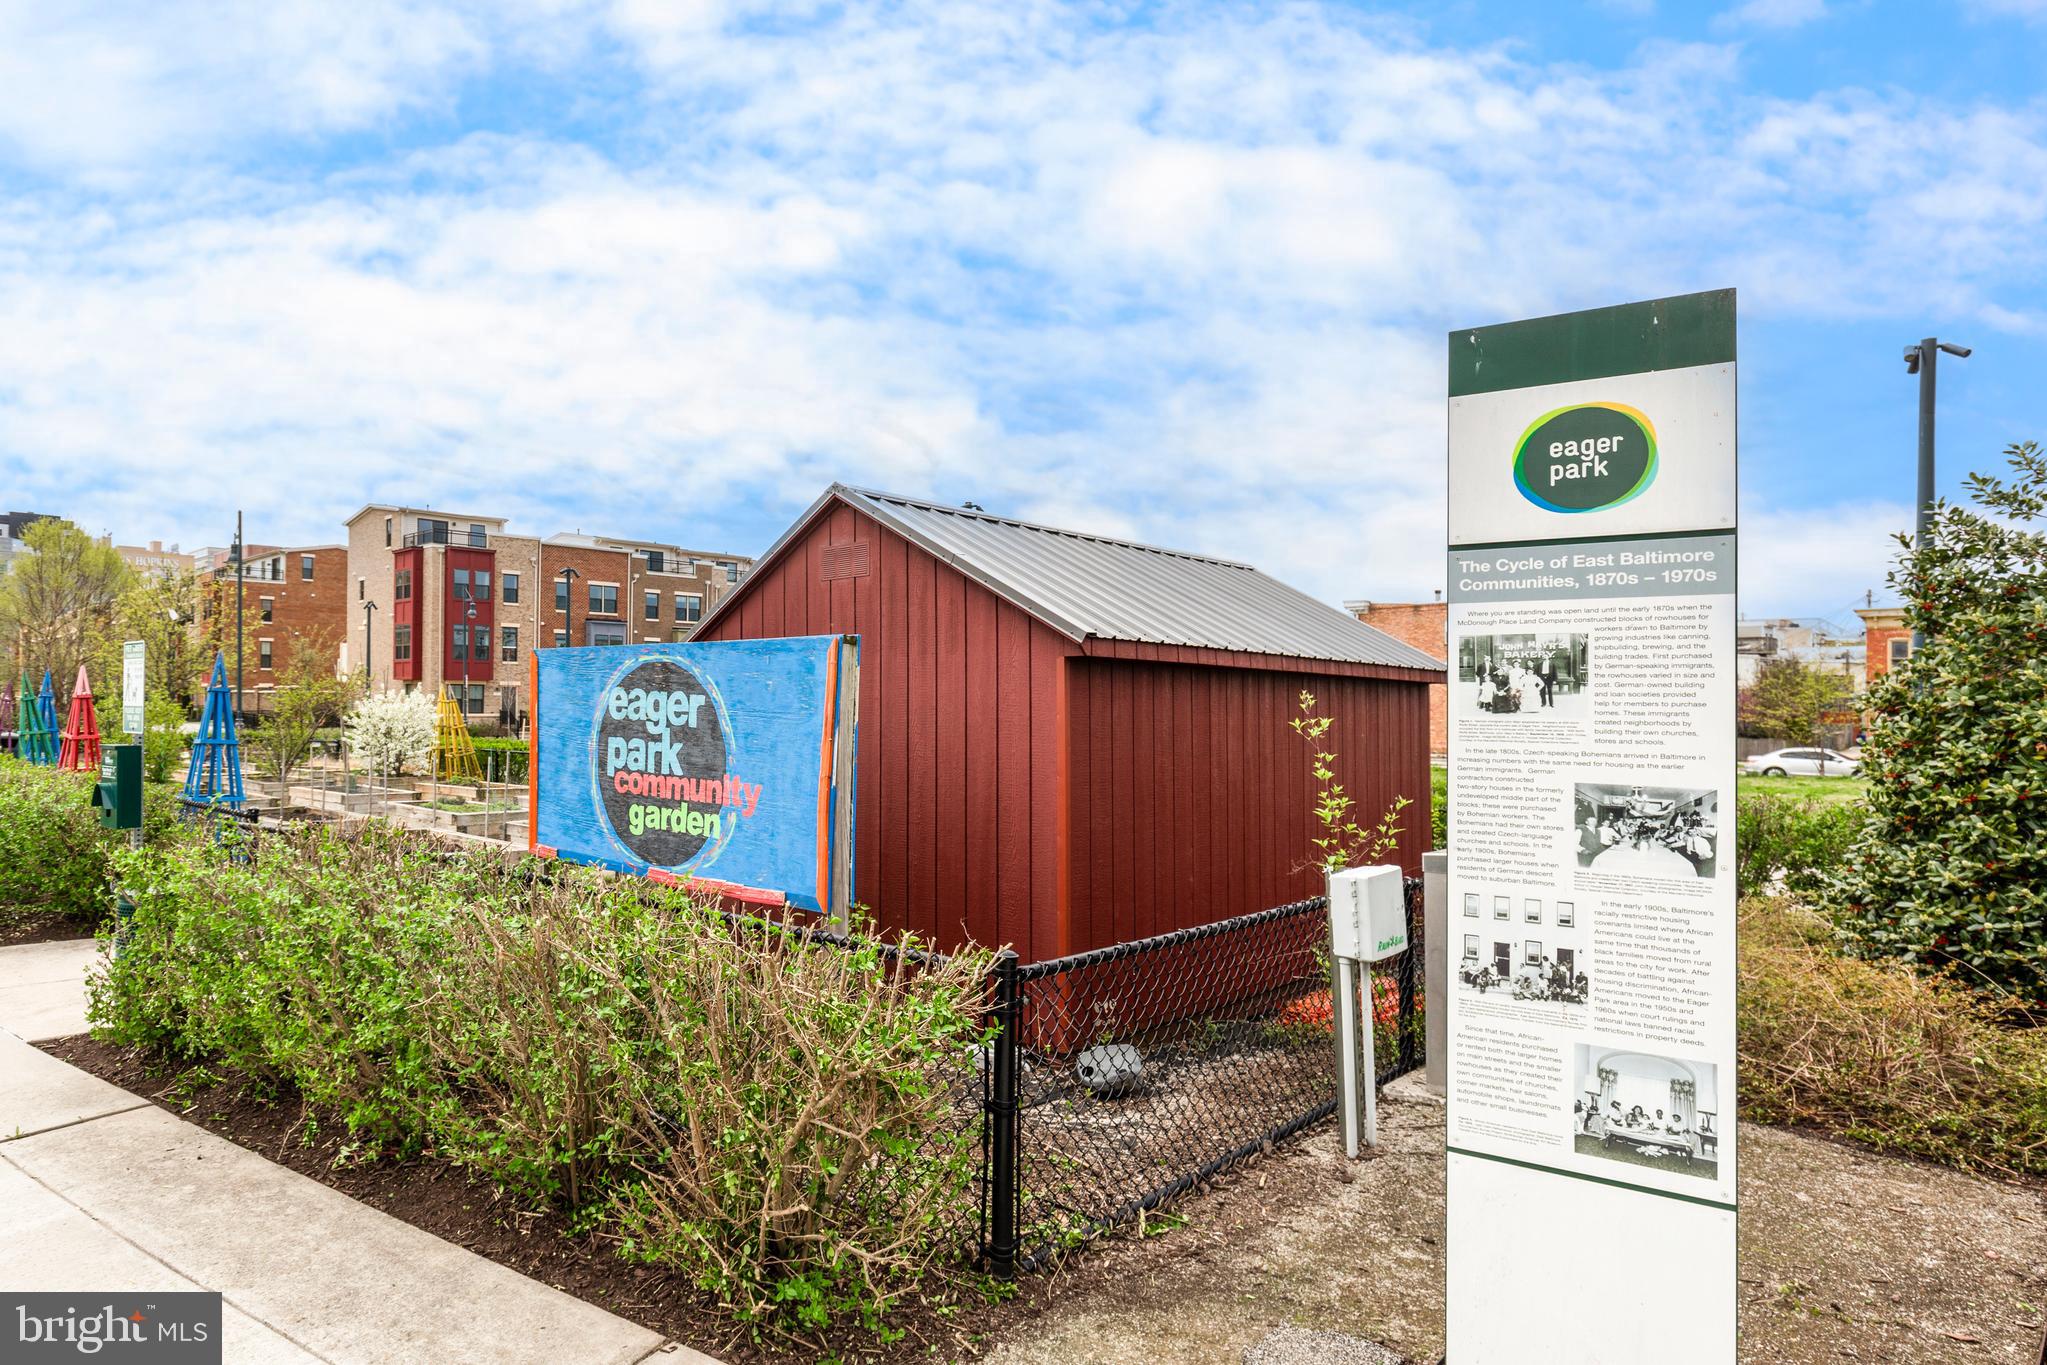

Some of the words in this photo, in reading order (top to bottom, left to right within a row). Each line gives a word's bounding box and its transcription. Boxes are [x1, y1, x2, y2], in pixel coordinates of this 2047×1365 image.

[1550, 435, 1624, 461] eager
[1550, 455, 1608, 486] park
[1458, 560, 1490, 573] The
[1495, 557, 1544, 573] Cycle
[1549, 555, 1568, 568] of
[1572, 553, 1614, 567] East
[1619, 550, 1715, 565] Baltimore
[1459, 574, 1579, 591] Communities,
[1585, 571, 1638, 586] 1870s
[1661, 568, 1717, 583] 1970s
[1457, 618, 1497, 626] McDonough
[1624, 623, 1648, 631] drawn
[1698, 623, 1708, 631] by
[1671, 652, 1712, 660] purchased
[1604, 662, 1669, 670] German-speaking
[1672, 681, 1704, 689] building
[608, 686, 705, 734] eager
[1681, 720, 1692, 728] by
[1594, 728, 1623, 736] building
[607, 728, 683, 777] park
[1522, 748, 1579, 757] Czech-speaking
[1580, 750, 1621, 758] Bohemians
[1456, 764, 1483, 772] German
[1604, 760, 1634, 769] housing
[614, 770, 762, 818] community
[628, 802, 721, 838] garden
[1671, 906, 1714, 916] Baltimore's
[1594, 910, 1619, 918] racially
[1621, 913, 1658, 921] restrictive
[1659, 915, 1690, 925] housing
[1593, 920, 1631, 928] covenants
[1633, 923, 1658, 931] limited
[1660, 926, 1683, 934] where
[1685, 928, 1713, 936] African
[1594, 928, 1633, 938] Americans
